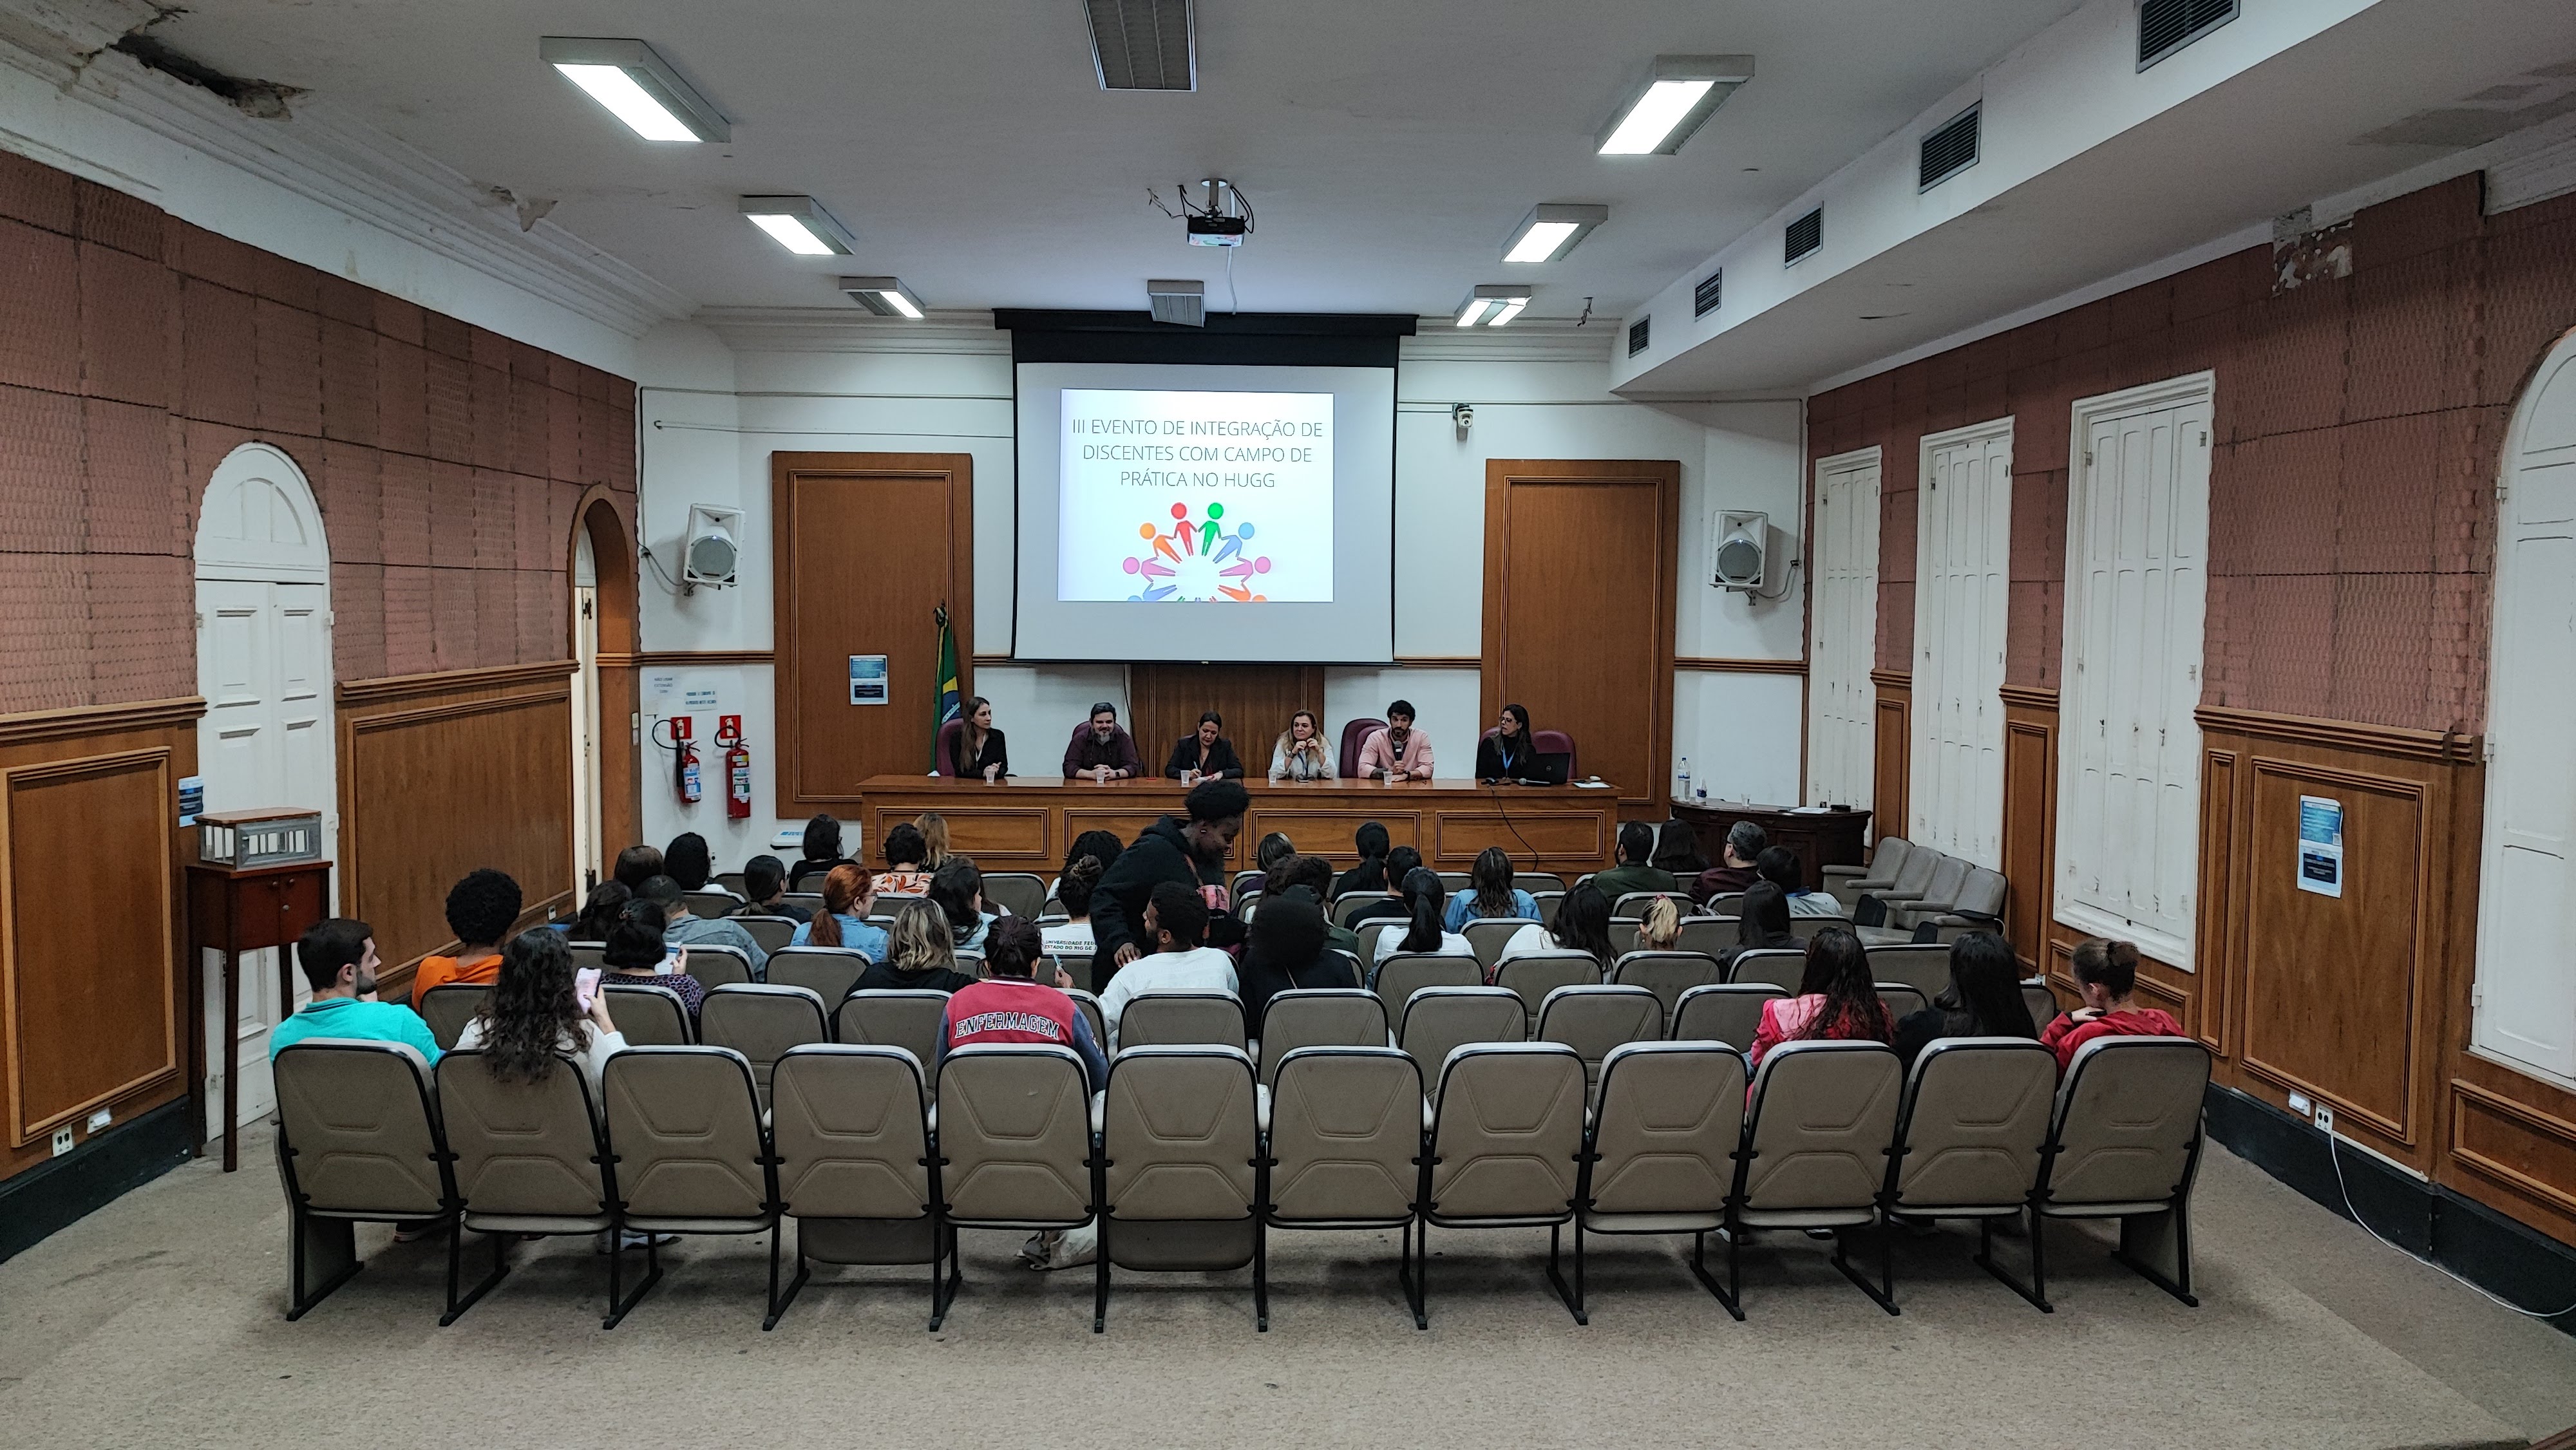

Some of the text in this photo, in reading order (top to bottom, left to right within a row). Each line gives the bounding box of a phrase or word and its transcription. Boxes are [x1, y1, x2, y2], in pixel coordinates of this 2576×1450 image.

[1072, 419, 1323, 440] III EVENTO DE INTEGRAÇÃO DE
[1083, 445, 1312, 462] DISCENTES COM CAMPO DE
[1121, 468, 1274, 487] PRÁTICA NO HUGG
[954, 1012, 1059, 1040] ENFERMAGEM
